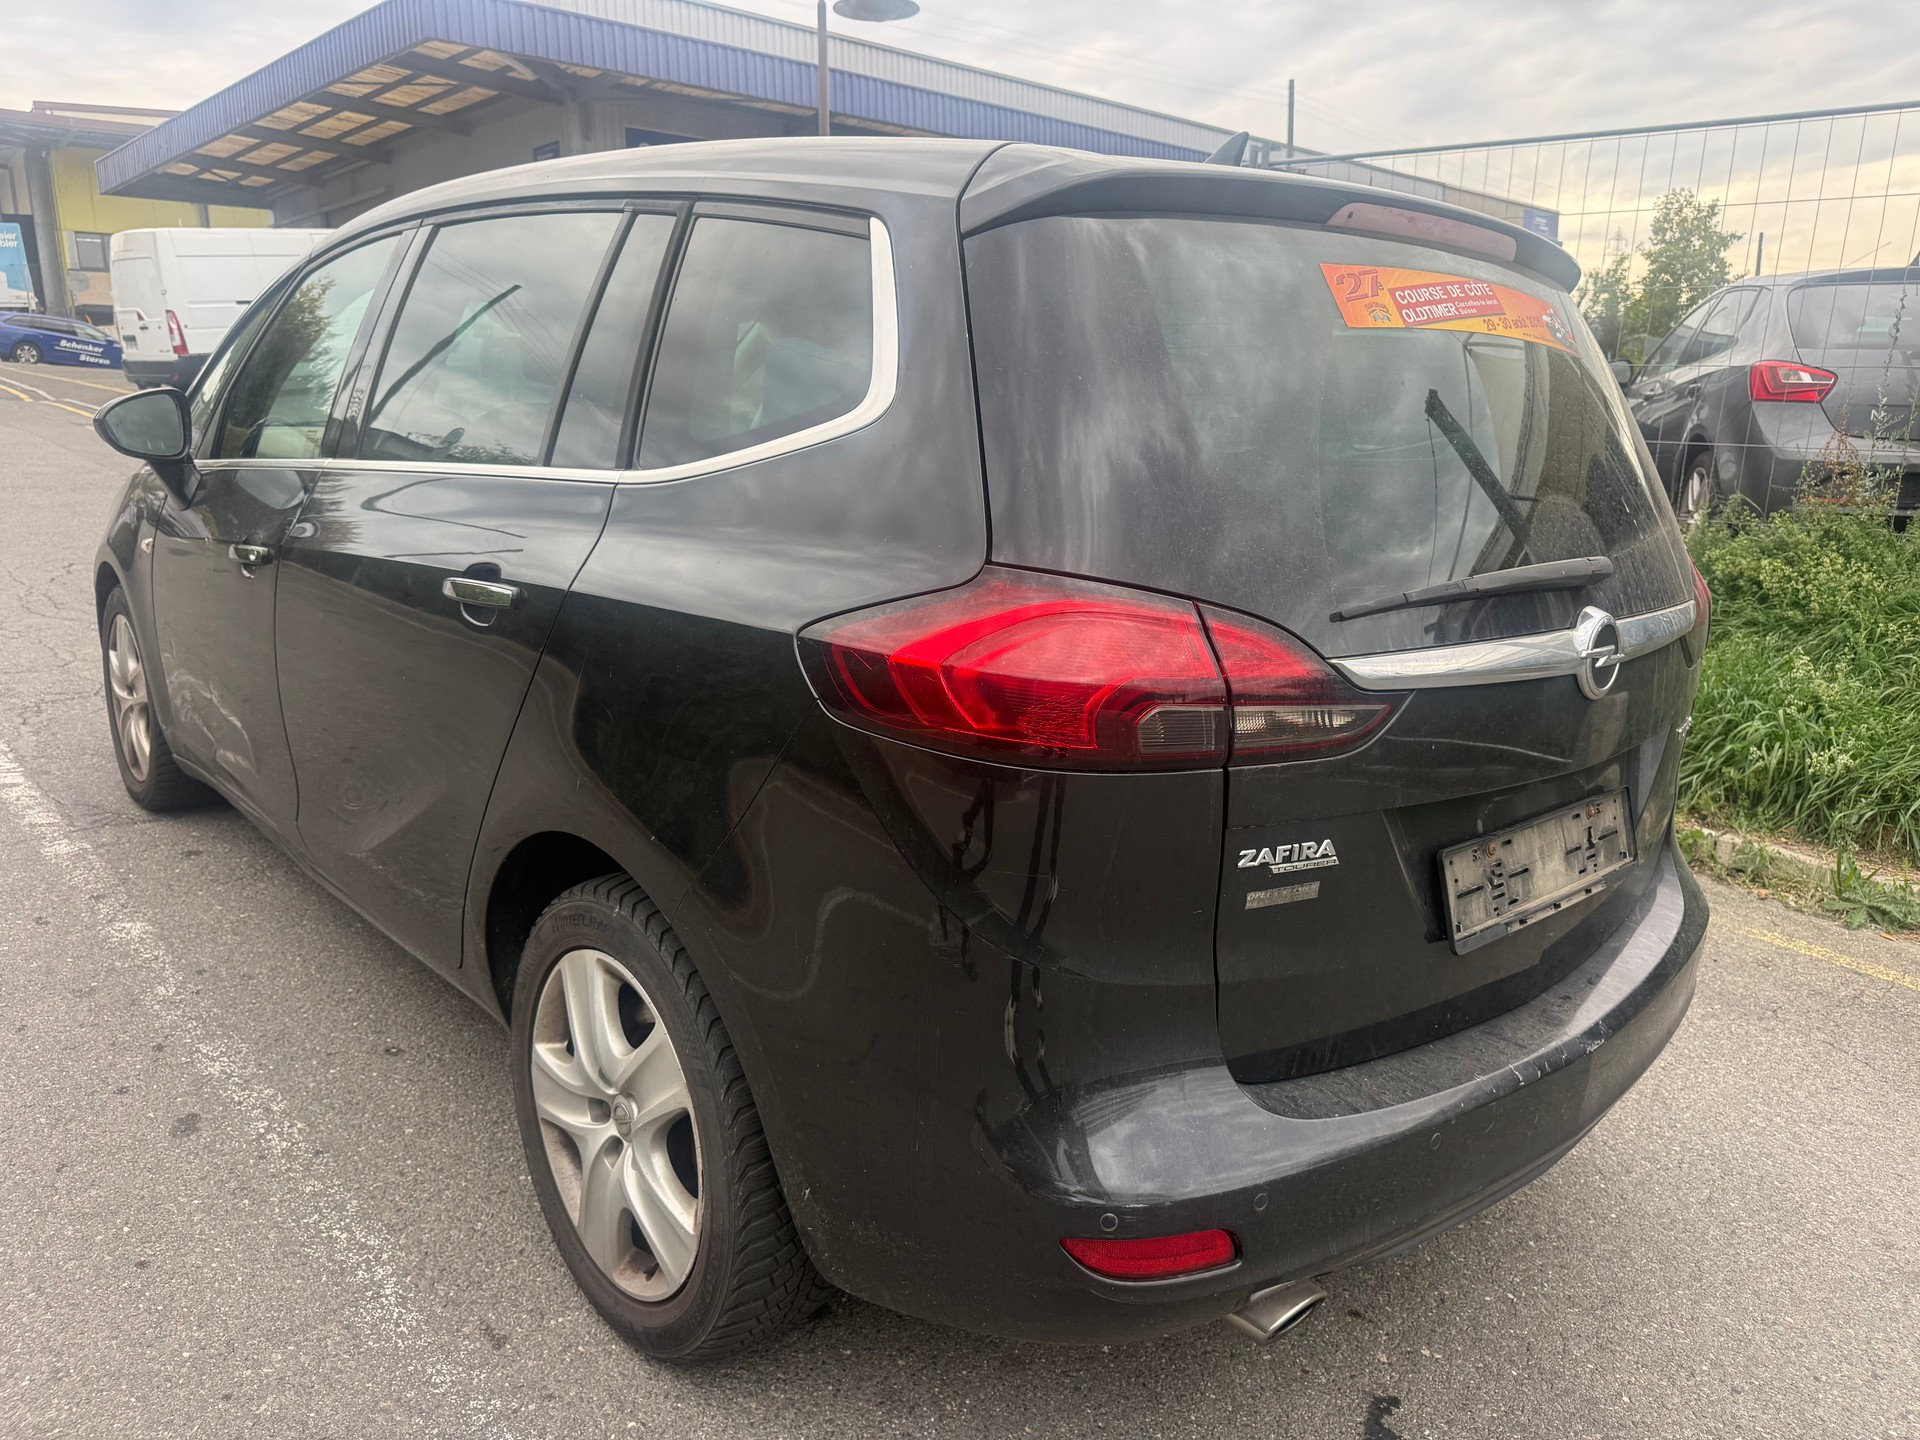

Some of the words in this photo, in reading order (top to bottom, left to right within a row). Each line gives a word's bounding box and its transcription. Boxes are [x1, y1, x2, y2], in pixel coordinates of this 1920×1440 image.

[1395, 286, 1447, 305] COURSE
[1446, 284, 1465, 298] DE
[1464, 281, 1493, 296] CÔTE
[1401, 303, 1460, 323] OLDTIMER
[1482, 318, 1497, 331] 29
[1499, 316, 1512, 330] 30
[59, 339, 104, 353] Schenker
[79, 354, 110, 365] Storen
[1237, 839, 1337, 868] ZAFIRA
[1272, 858, 1337, 873] TOURER
